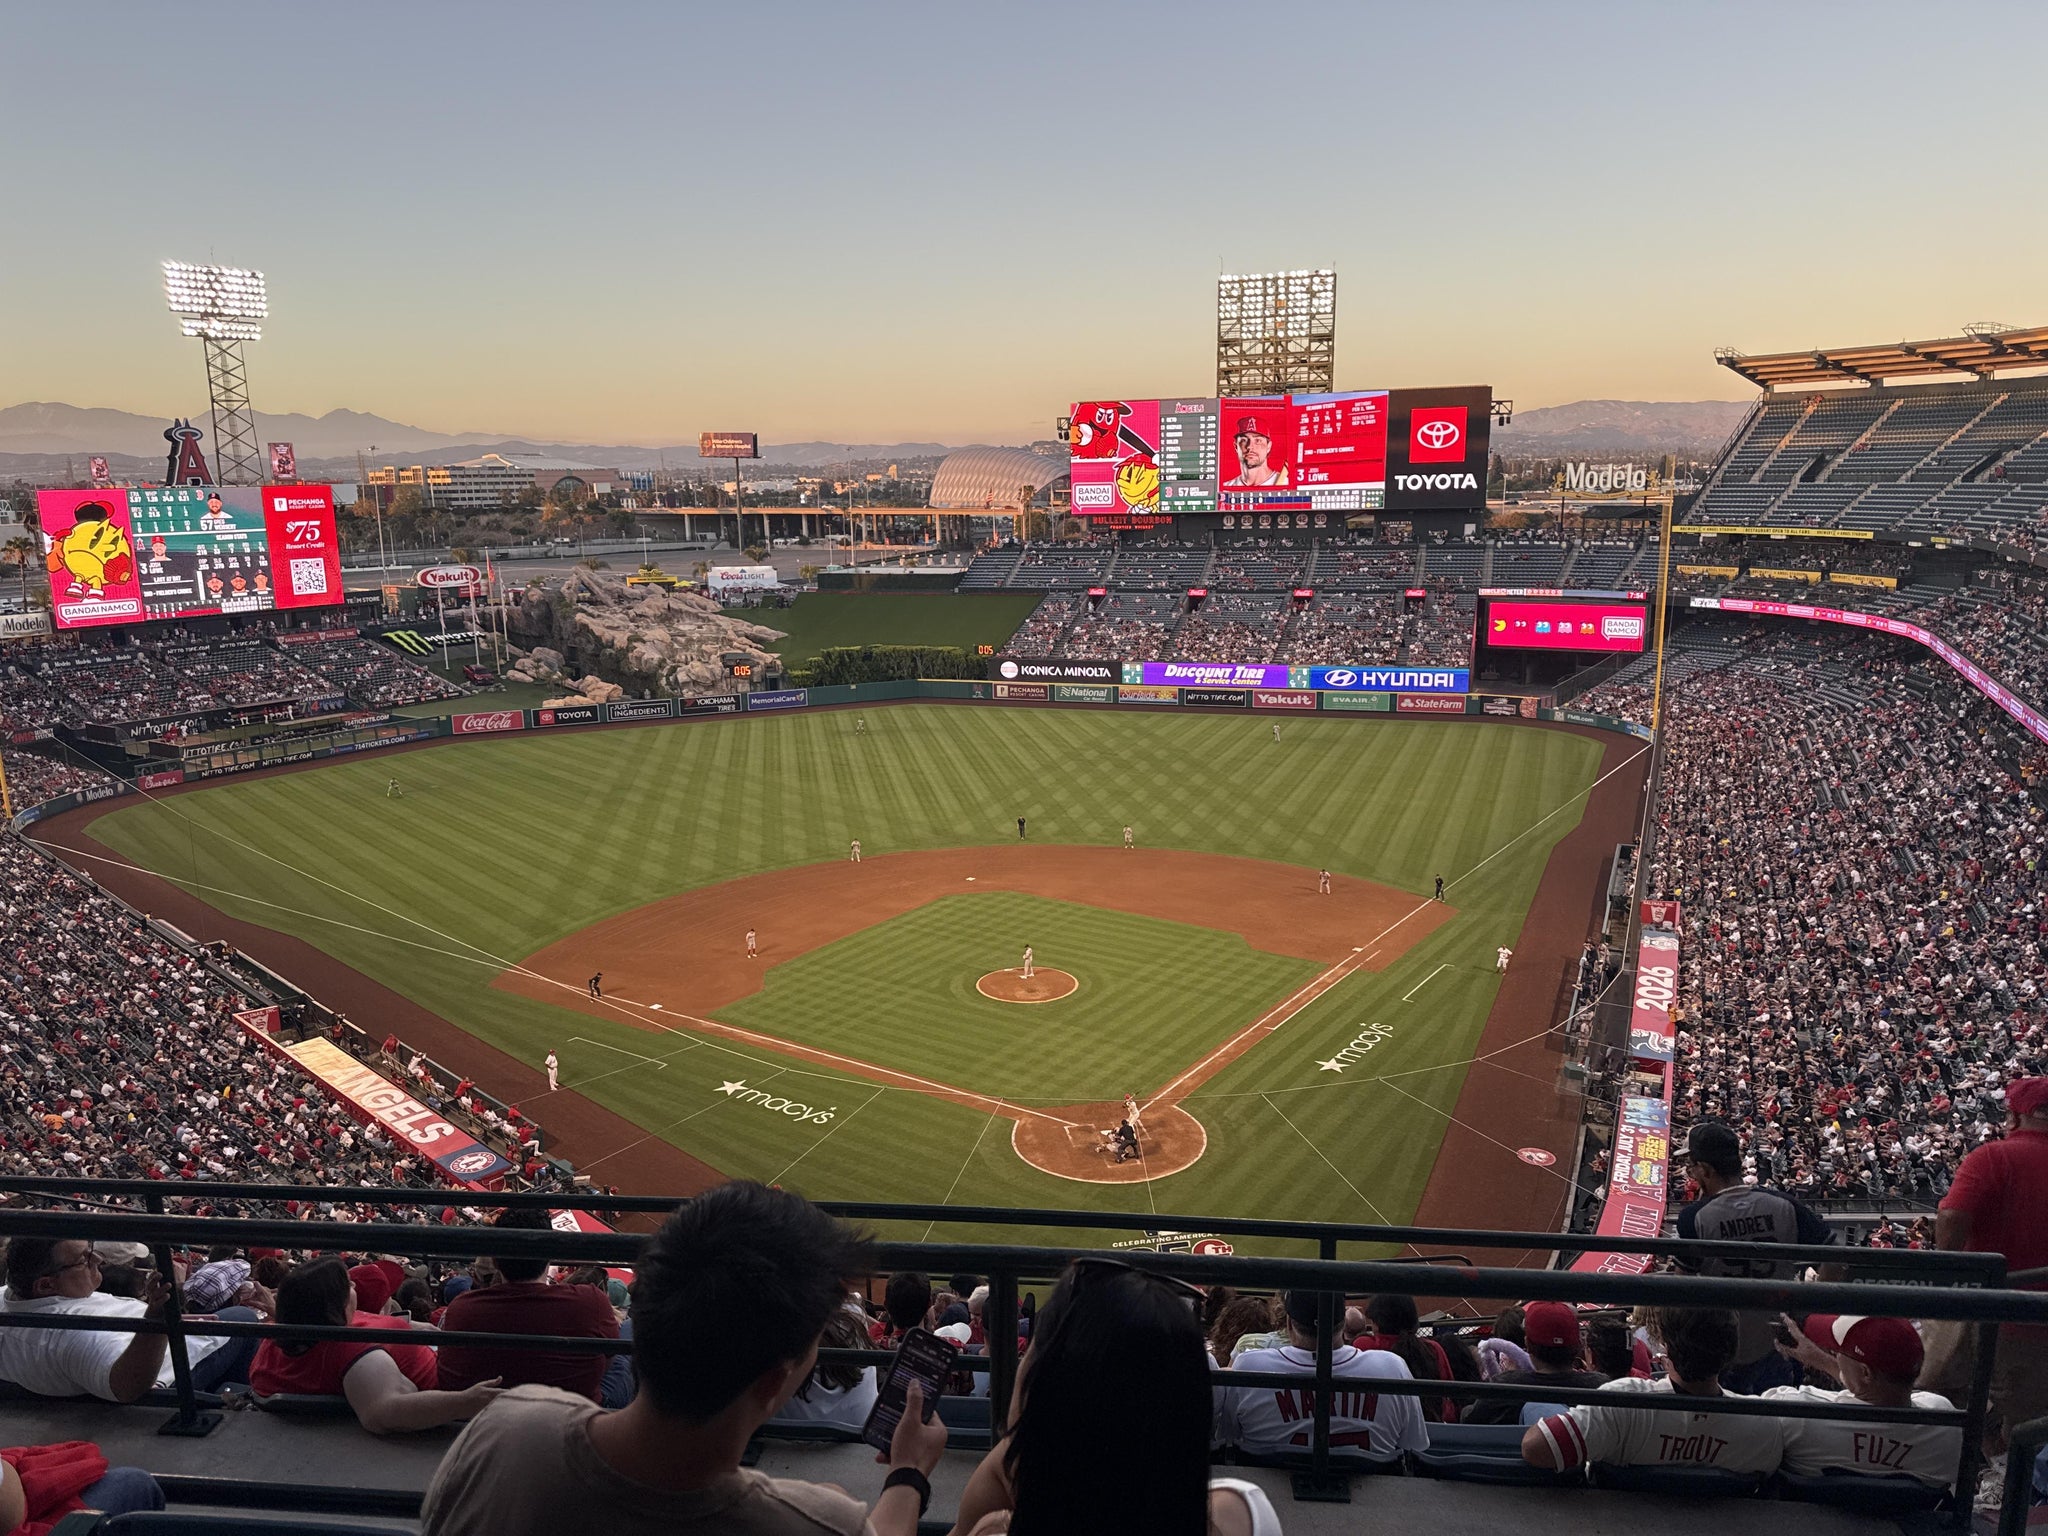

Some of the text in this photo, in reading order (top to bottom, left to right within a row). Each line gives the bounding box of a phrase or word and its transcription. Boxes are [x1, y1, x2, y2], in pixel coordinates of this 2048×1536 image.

[1297, 469, 1304, 481] 3
[1308, 473, 1329, 482] LOWE
[1566, 462, 1646, 489] Modelo
[1394, 474, 1478, 490] TOYOTA
[1178, 487, 1189, 497] 57
[200, 520, 213, 530] 57
[1092, 516, 1172, 524] BULLEIT BOURBON
[286, 520, 321, 542] $75
[140, 563, 148, 574] 3
[430, 571, 470, 582] Yakult
[720, 572, 743, 580] Coors
[64, 604, 135, 616] BANDAI NAMCO
[4, 618, 45, 631] Modelo
[424, 630, 485, 642] MONSTER
[1021, 665, 1111, 677] KONICA MINOLTA
[1164, 665, 1265, 678] DISCOUNT TIRE
[1362, 672, 1454, 687] HYUNDAI
[1070, 687, 1107, 697] National
[1122, 688, 1156, 699] Surfside
[1210, 694, 1243, 702] TIRE.COM
[696, 697, 735, 705] YOKOHAMA
[751, 696, 796, 705] MemorialCare
[1258, 694, 1312, 705] Yakult
[557, 710, 592, 720] TOYOTA
[614, 707, 666, 717] INGREDIENTS
[1567, 714, 1594, 722] FMB.com
[462, 713, 513, 731] Coca-Cola
[355, 735, 406, 750] 714TICKETS.COM
[262, 752, 312, 768] NITTO TIRE.COM
[202, 762, 255, 778] NITTO TIRE.COM
[86, 786, 114, 801] Modelo
[1636, 966, 1675, 1012] 2026
[1620, 1124, 1636, 1134] 31
[1618, 1132, 1634, 1153] JULY
[1645, 1134, 1660, 1161] JERSEY
[1613, 1152, 1635, 1183] FRIDAY,
[1720, 1214, 1775, 1237] ANDREW
[1112, 1236, 1172, 1248] CELEBRATING
[1275, 1389, 1379, 1423] MATIN
[1659, 1434, 1728, 1464] TROUT
[1853, 1432, 1914, 1469] FUZZ
